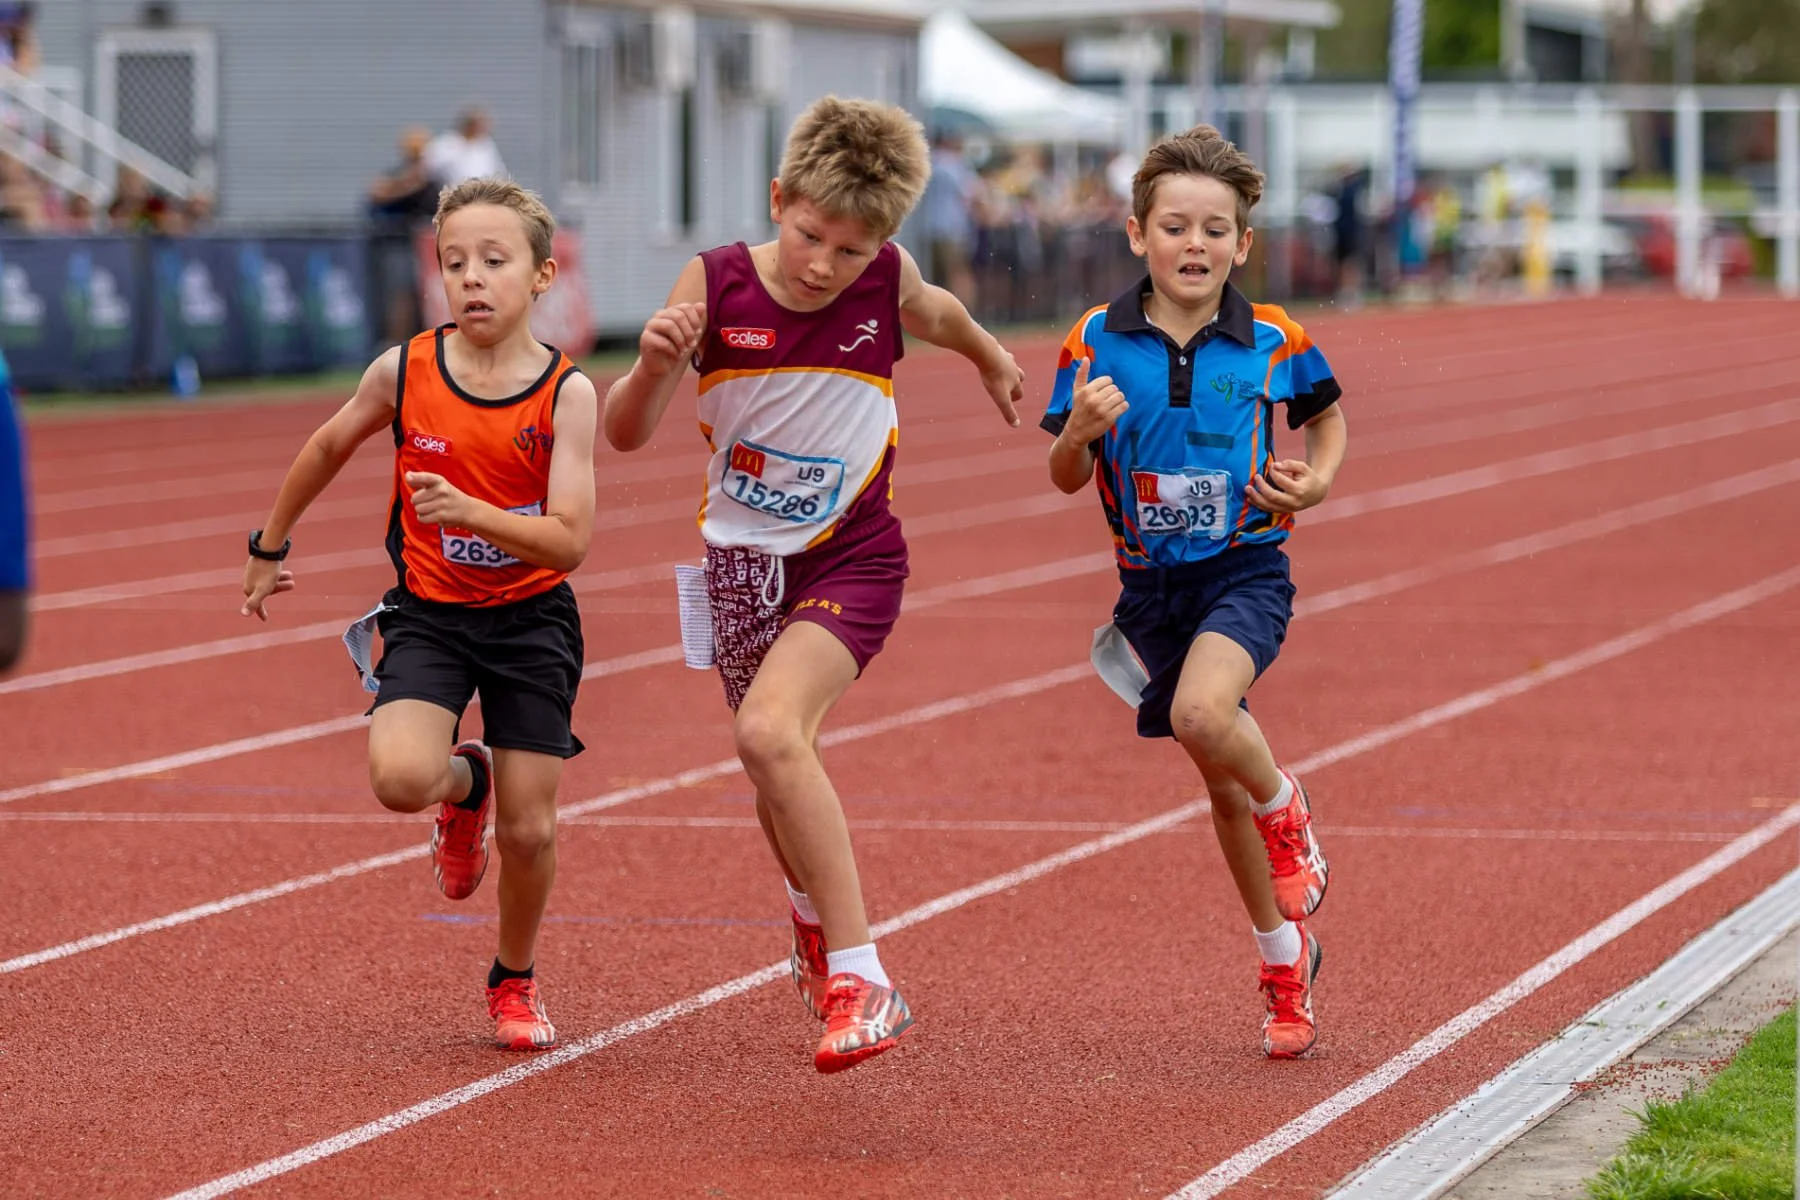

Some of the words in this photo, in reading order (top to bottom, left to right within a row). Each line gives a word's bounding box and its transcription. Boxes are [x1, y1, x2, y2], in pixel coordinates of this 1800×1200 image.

[728, 332, 768, 346] coles
[413, 436, 446, 453] coles
[797, 467, 825, 483] U9
[735, 474, 821, 516] 15286
[1190, 480, 1212, 496] U9
[450, 539, 512, 563] 263
[723, 666, 759, 678] ASPLE
